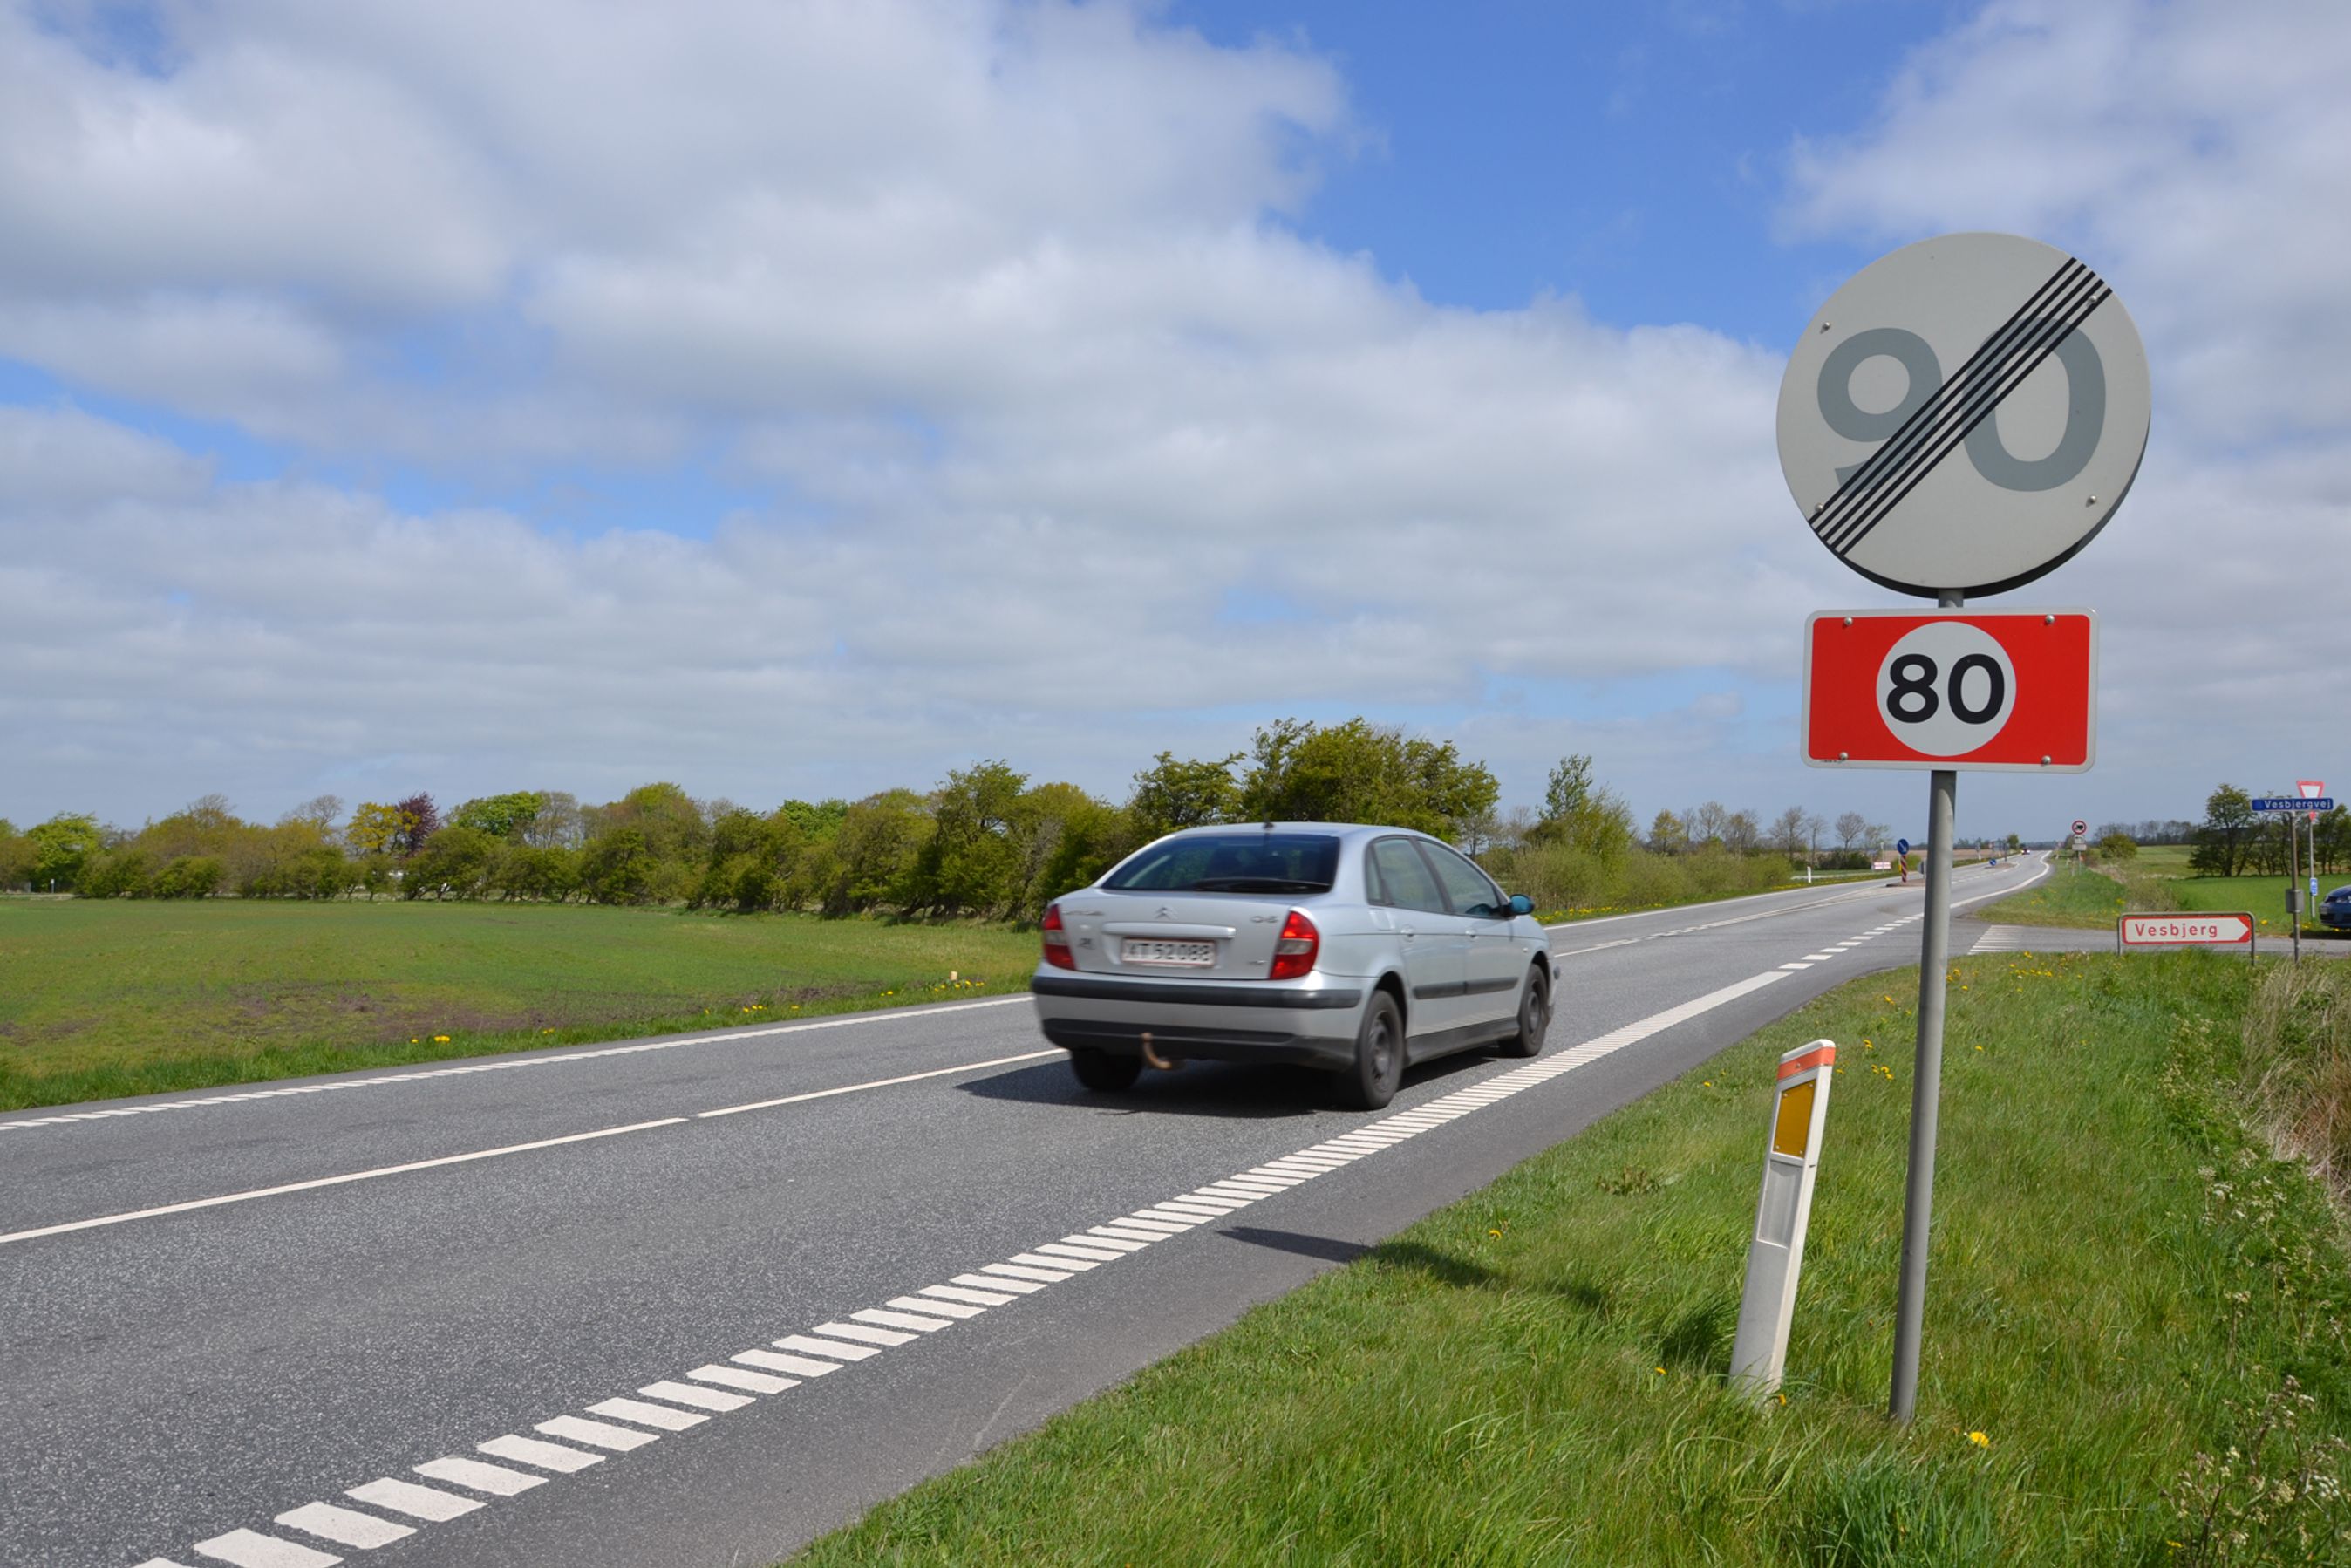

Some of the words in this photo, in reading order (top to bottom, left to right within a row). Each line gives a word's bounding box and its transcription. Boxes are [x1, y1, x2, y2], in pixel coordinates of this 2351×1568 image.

[1816, 317, 2106, 497] 90
[1886, 653, 2005, 725] 80
[2264, 800, 2331, 809] Vesbjergvej
[2135, 923, 2218, 937] Vesbjerg
